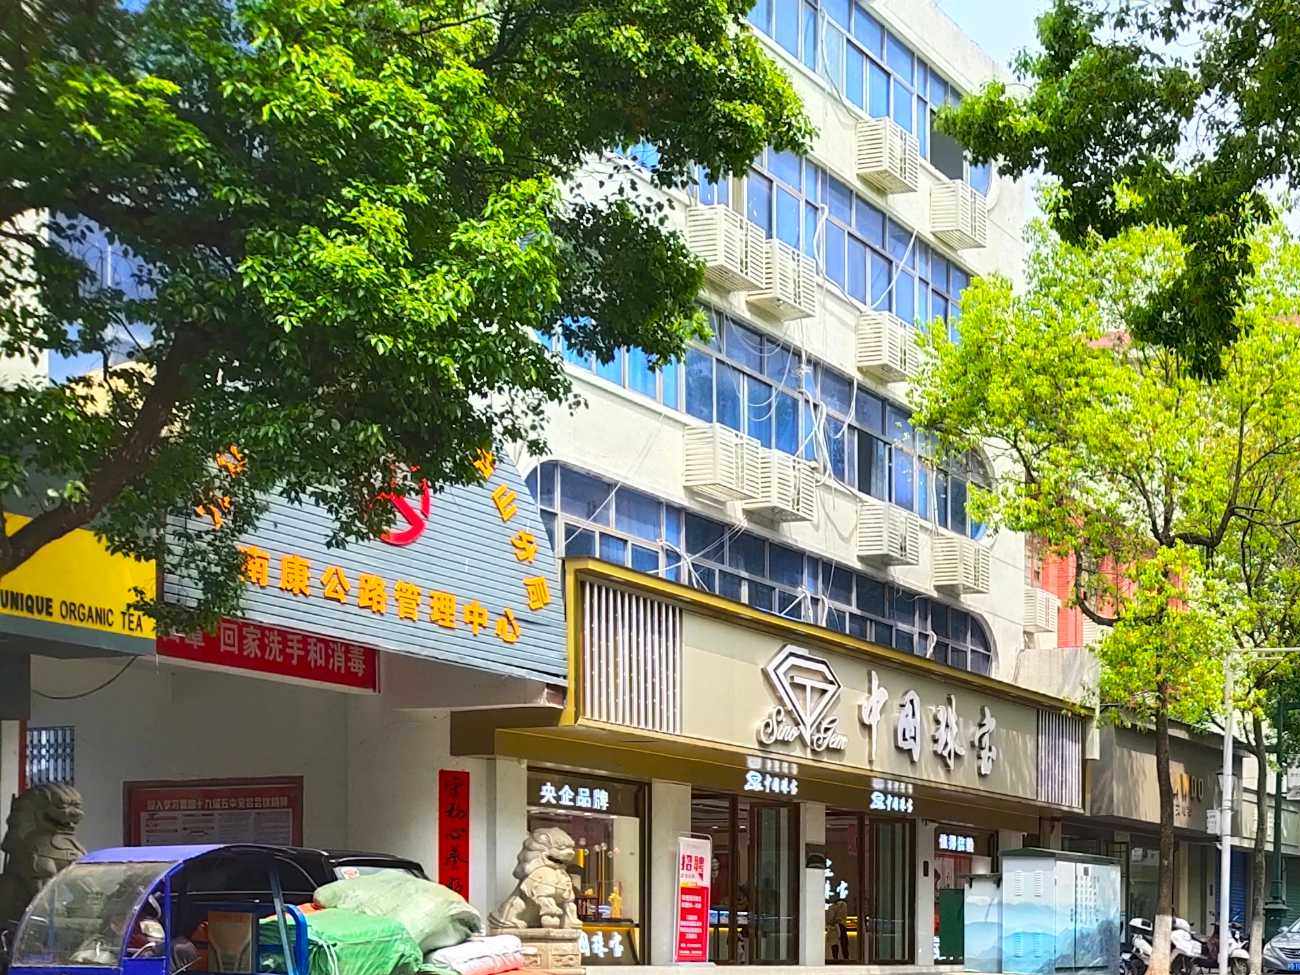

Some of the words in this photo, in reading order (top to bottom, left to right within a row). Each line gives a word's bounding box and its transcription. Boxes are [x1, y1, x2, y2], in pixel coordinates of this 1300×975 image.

[0, 589, 53, 617] UNIQUE
[60, 600, 114, 627] ORGANIC
[121, 611, 143, 632] TEA
[238, 545, 520, 644] 南康公路管理中心
[220, 623, 366, 676] 回家洗手和消毒
[757, 705, 800, 744] Sino
[811, 716, 848, 751] Gem
[858, 670, 996, 775] 中国珠宝
[540, 782, 609, 810] 央企品牌
[681, 854, 704, 874] 招聘
